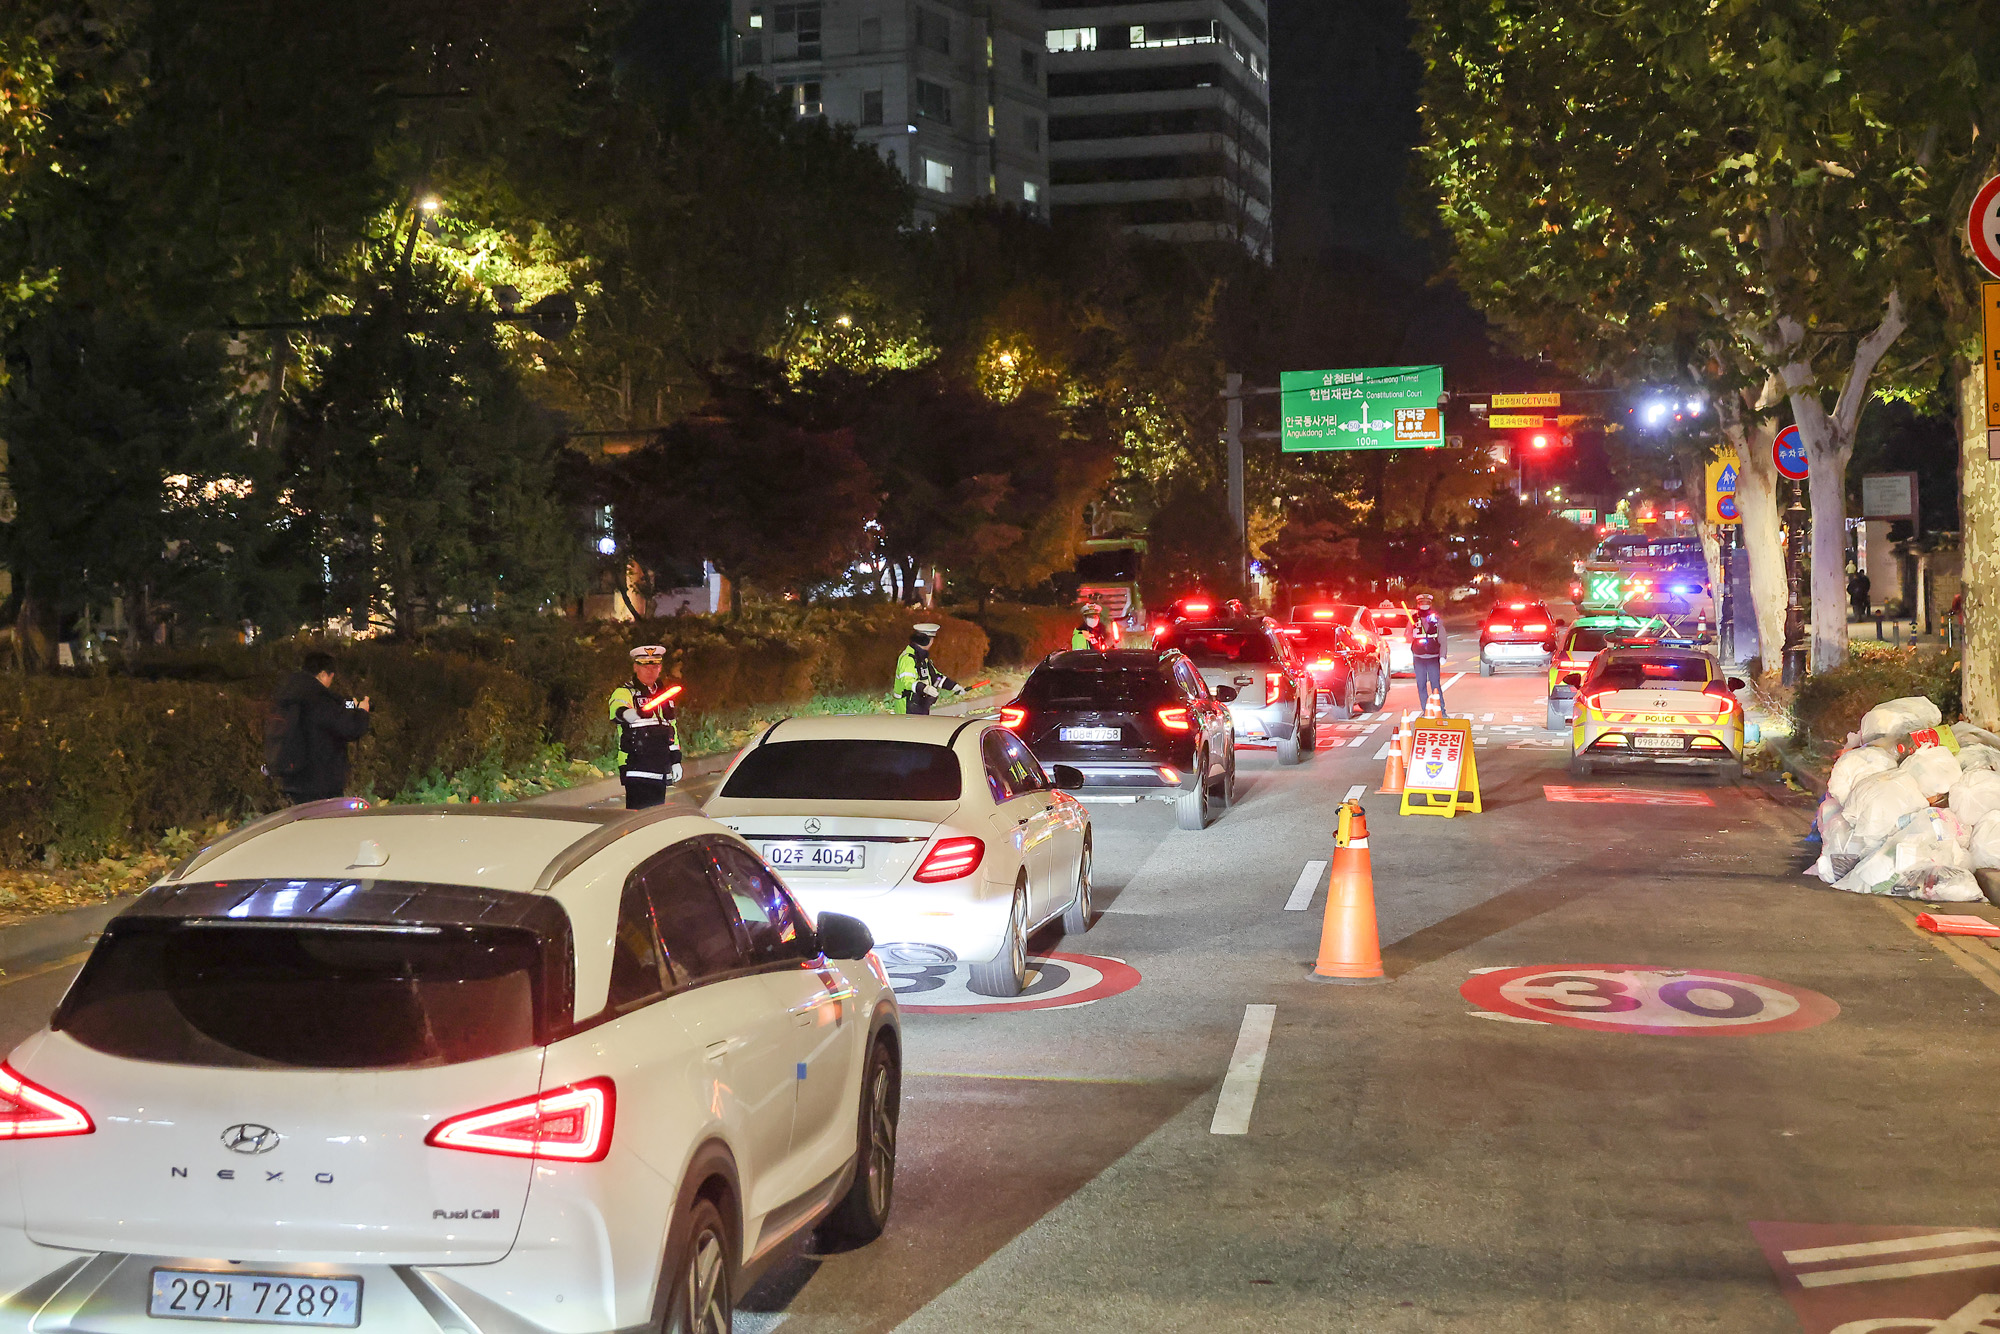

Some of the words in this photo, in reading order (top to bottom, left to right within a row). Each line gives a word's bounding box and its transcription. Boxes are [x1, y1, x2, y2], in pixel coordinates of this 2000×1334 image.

[1322, 372, 1364, 386] 삼청터널
[1401, 374, 1419, 383] Tunnel
[1309, 387, 1364, 401] 헌법재판소
[1366, 391, 1404, 399] Constitutional
[1406, 389, 1423, 398] Court
[1285, 414, 1337, 428] 안국동사거리
[1396, 409, 1426, 421] 창덕궁
[1349, 422, 1359, 430] 50
[1372, 421, 1382, 429] 50
[1286, 428, 1323, 438] Angukdong
[1325, 427, 1337, 436] Jct
[1356, 437, 1378, 446] 100m
[1780, 447, 1805, 459] 주차금
[1645, 715, 1676, 723] POLICE
[1095, 729, 1119, 739] 7758
[1416, 732, 1461, 747] 음주운전
[1660, 739, 1681, 747] 6625
[771, 847, 805, 865] 02주
[811, 848, 855, 865] 4054
[1523, 975, 1765, 1019] 30
[170, 1165, 335, 1185] NEXO
[432, 1208, 468, 1221] Fuel
[471, 1208, 500, 1220] Cell
[169, 1277, 234, 1313] 29가
[252, 1281, 340, 1318] 7289
